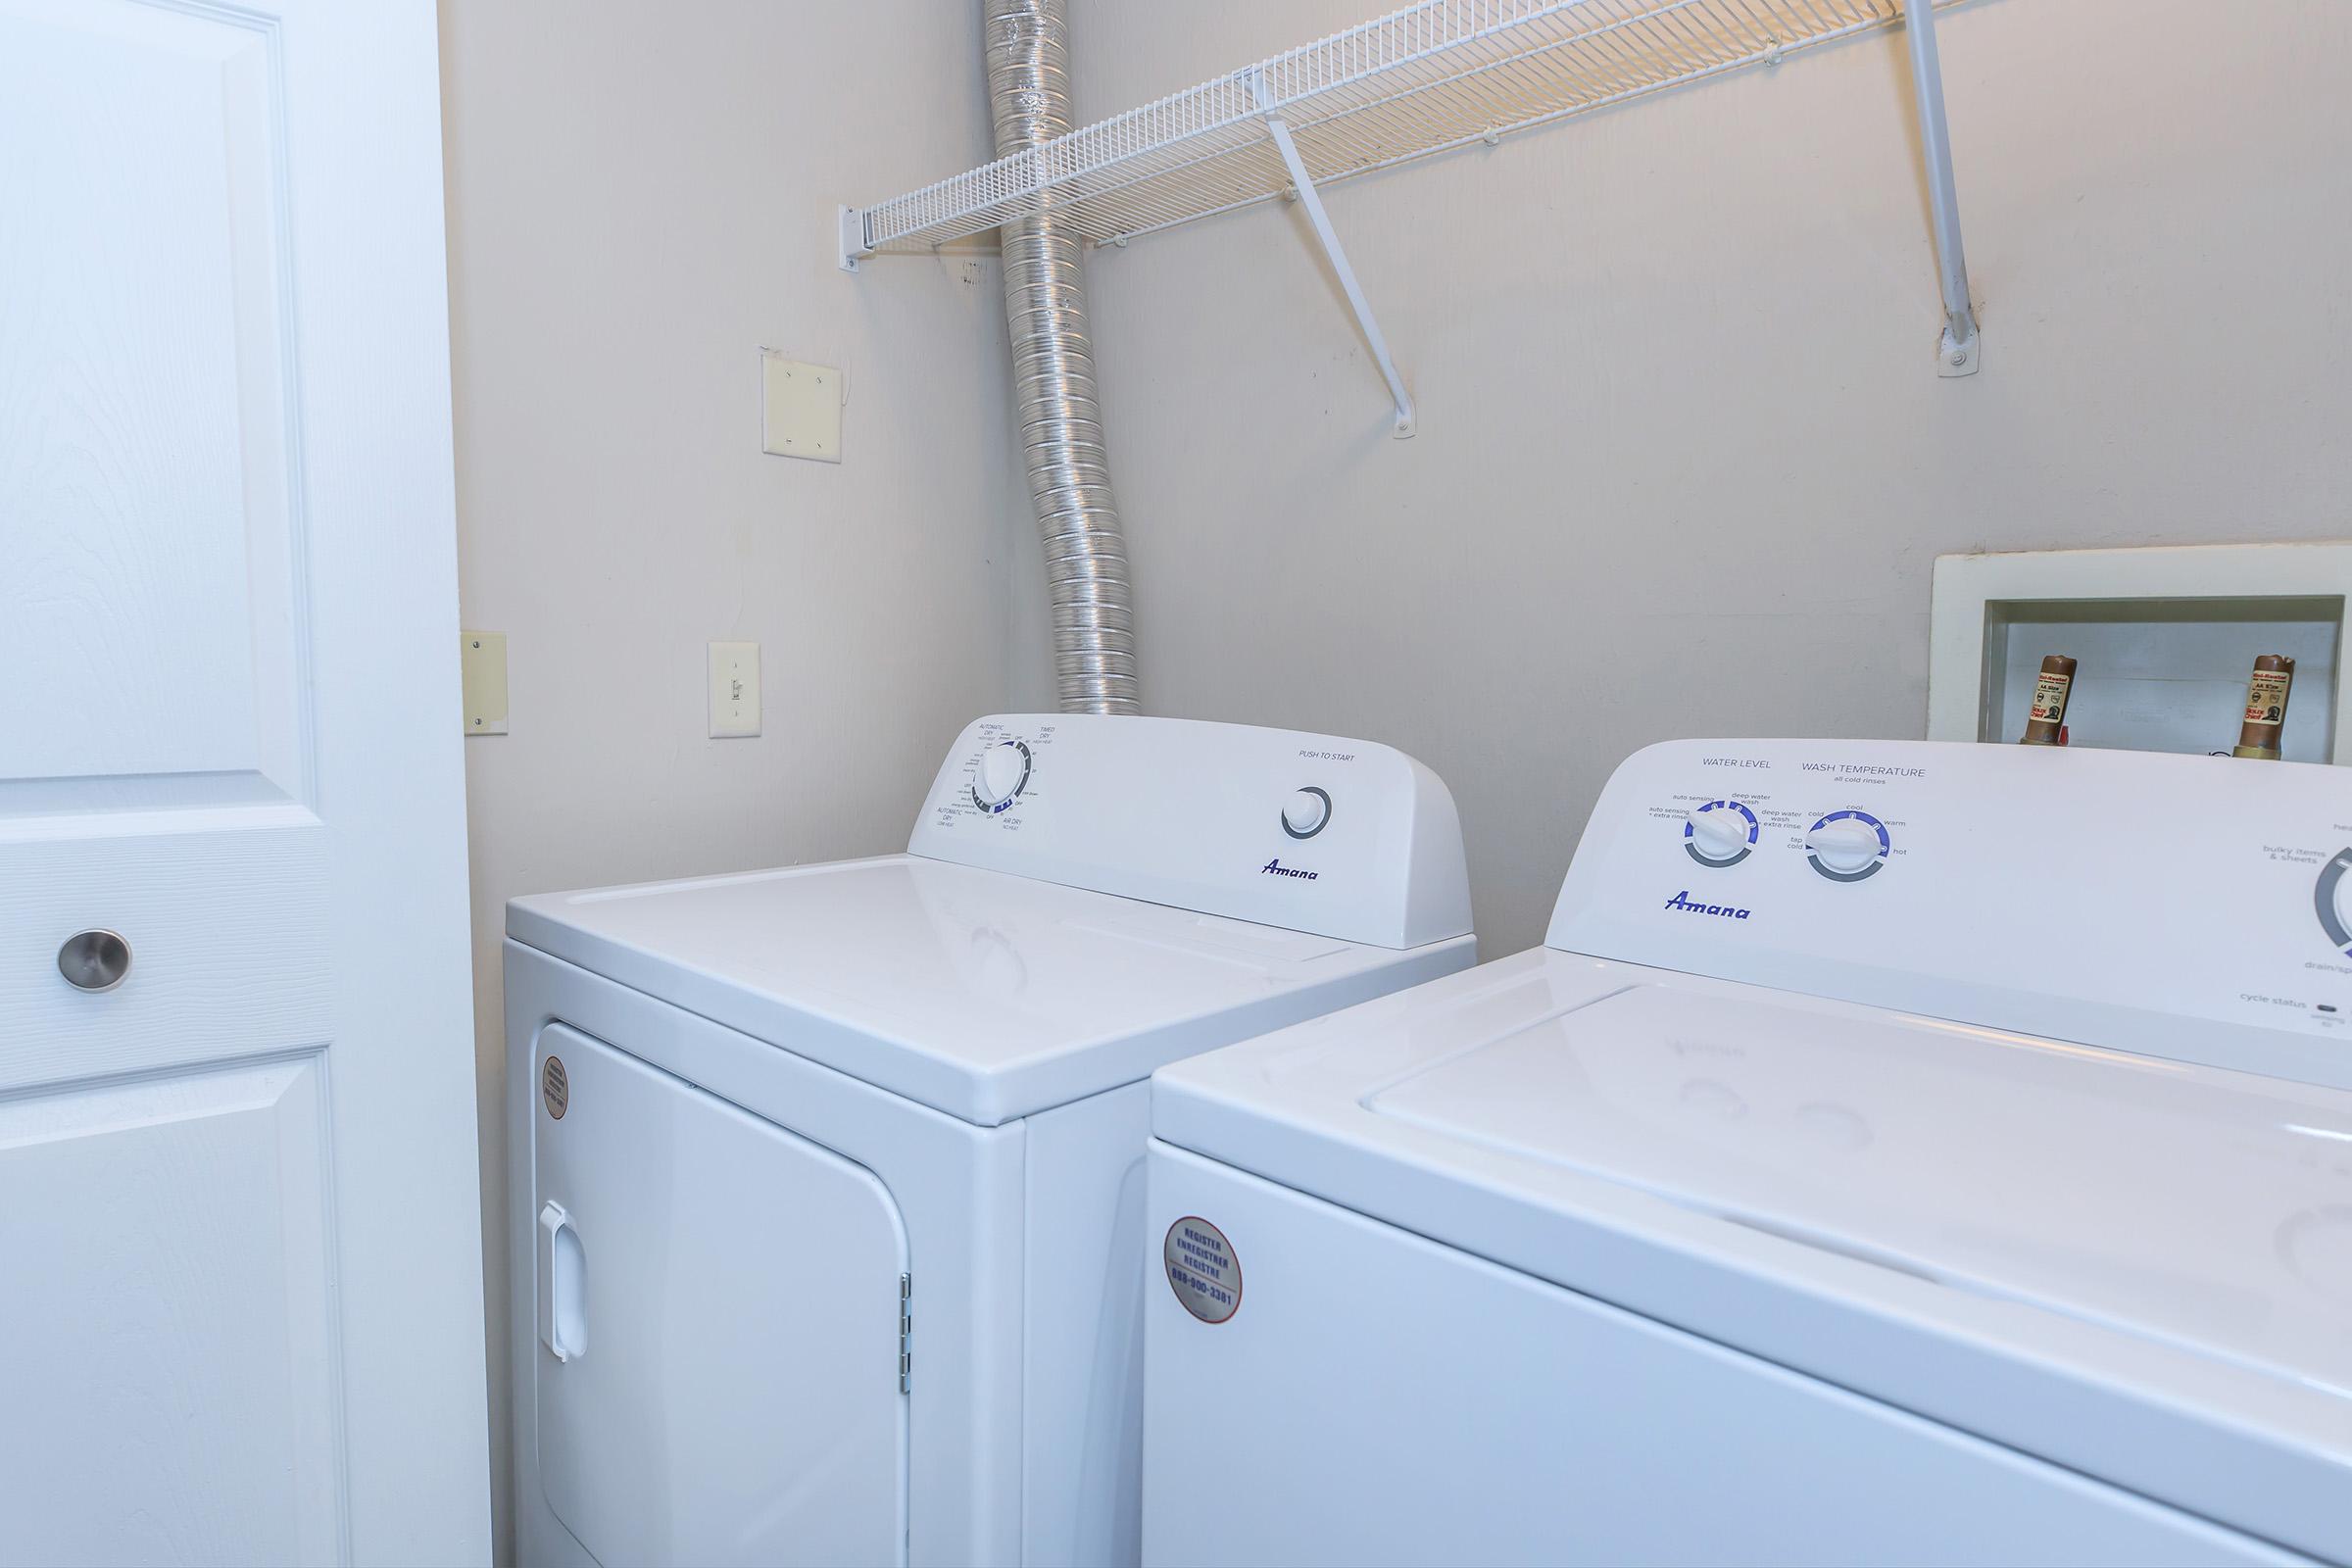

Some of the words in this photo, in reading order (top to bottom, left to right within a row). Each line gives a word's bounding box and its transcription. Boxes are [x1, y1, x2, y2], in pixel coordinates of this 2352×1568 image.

[1298, 750, 1319, 759] PUSH
[1331, 753, 1355, 762] START
[1702, 759, 1738, 767] WATER
[1740, 760, 1772, 768] LEVEL
[1801, 762, 1836, 772] WASH
[1840, 764, 1927, 778] TEMPERATURE
[2263, 845, 2293, 855] bulky
[2296, 849, 2327, 858] items
[2280, 856, 2318, 864] sheets
[1261, 858, 1319, 880] Amana
[1664, 890, 1751, 920] Amana
[2240, 994, 2270, 1003] cycle
[2272, 998, 2307, 1008] status
[1184, 1227, 1222, 1252] REGISTER
[1177, 1238, 1229, 1270] ENREGISTRER
[1171, 1267, 1232, 1306] 888-900-3381
